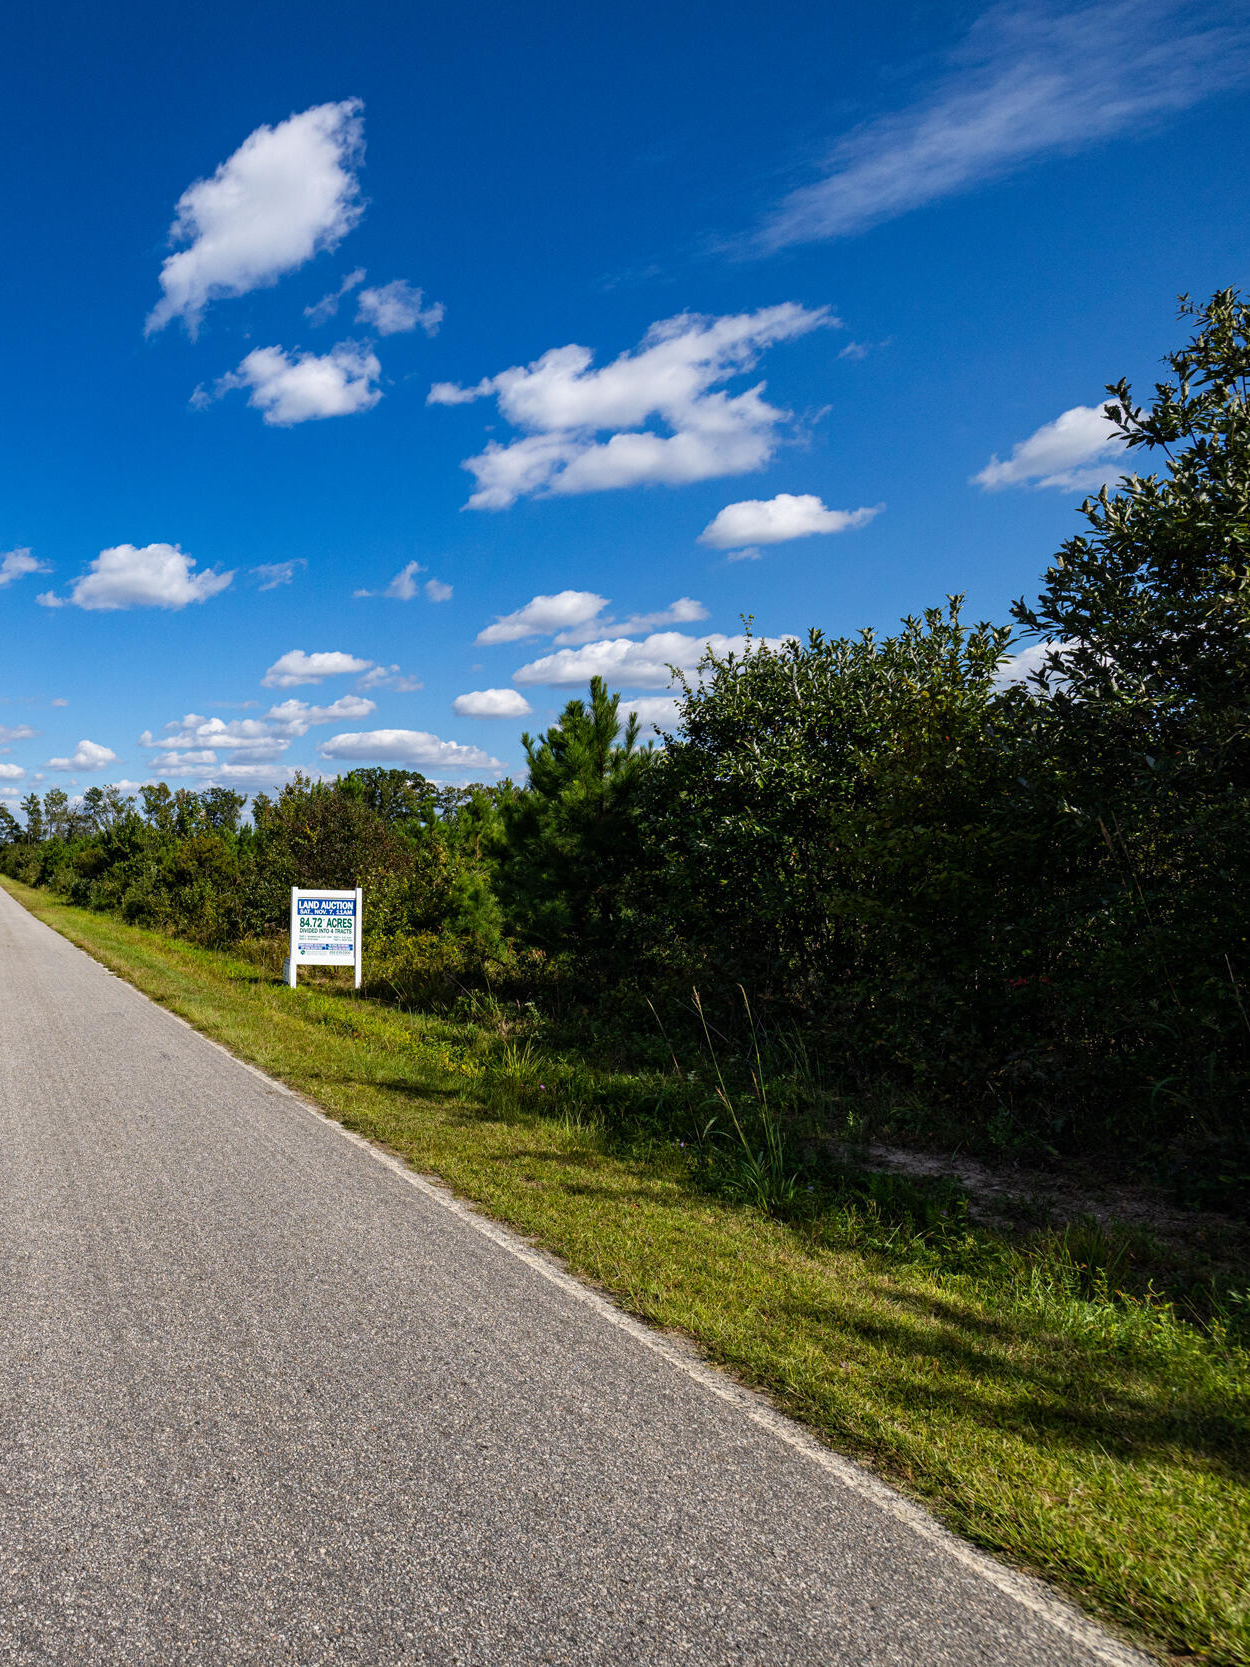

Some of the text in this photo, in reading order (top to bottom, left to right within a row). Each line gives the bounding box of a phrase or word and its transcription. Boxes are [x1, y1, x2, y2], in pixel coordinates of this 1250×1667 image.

[299, 900, 354, 910] LAND AUCTION
[326, 917, 353, 928] ACRES
